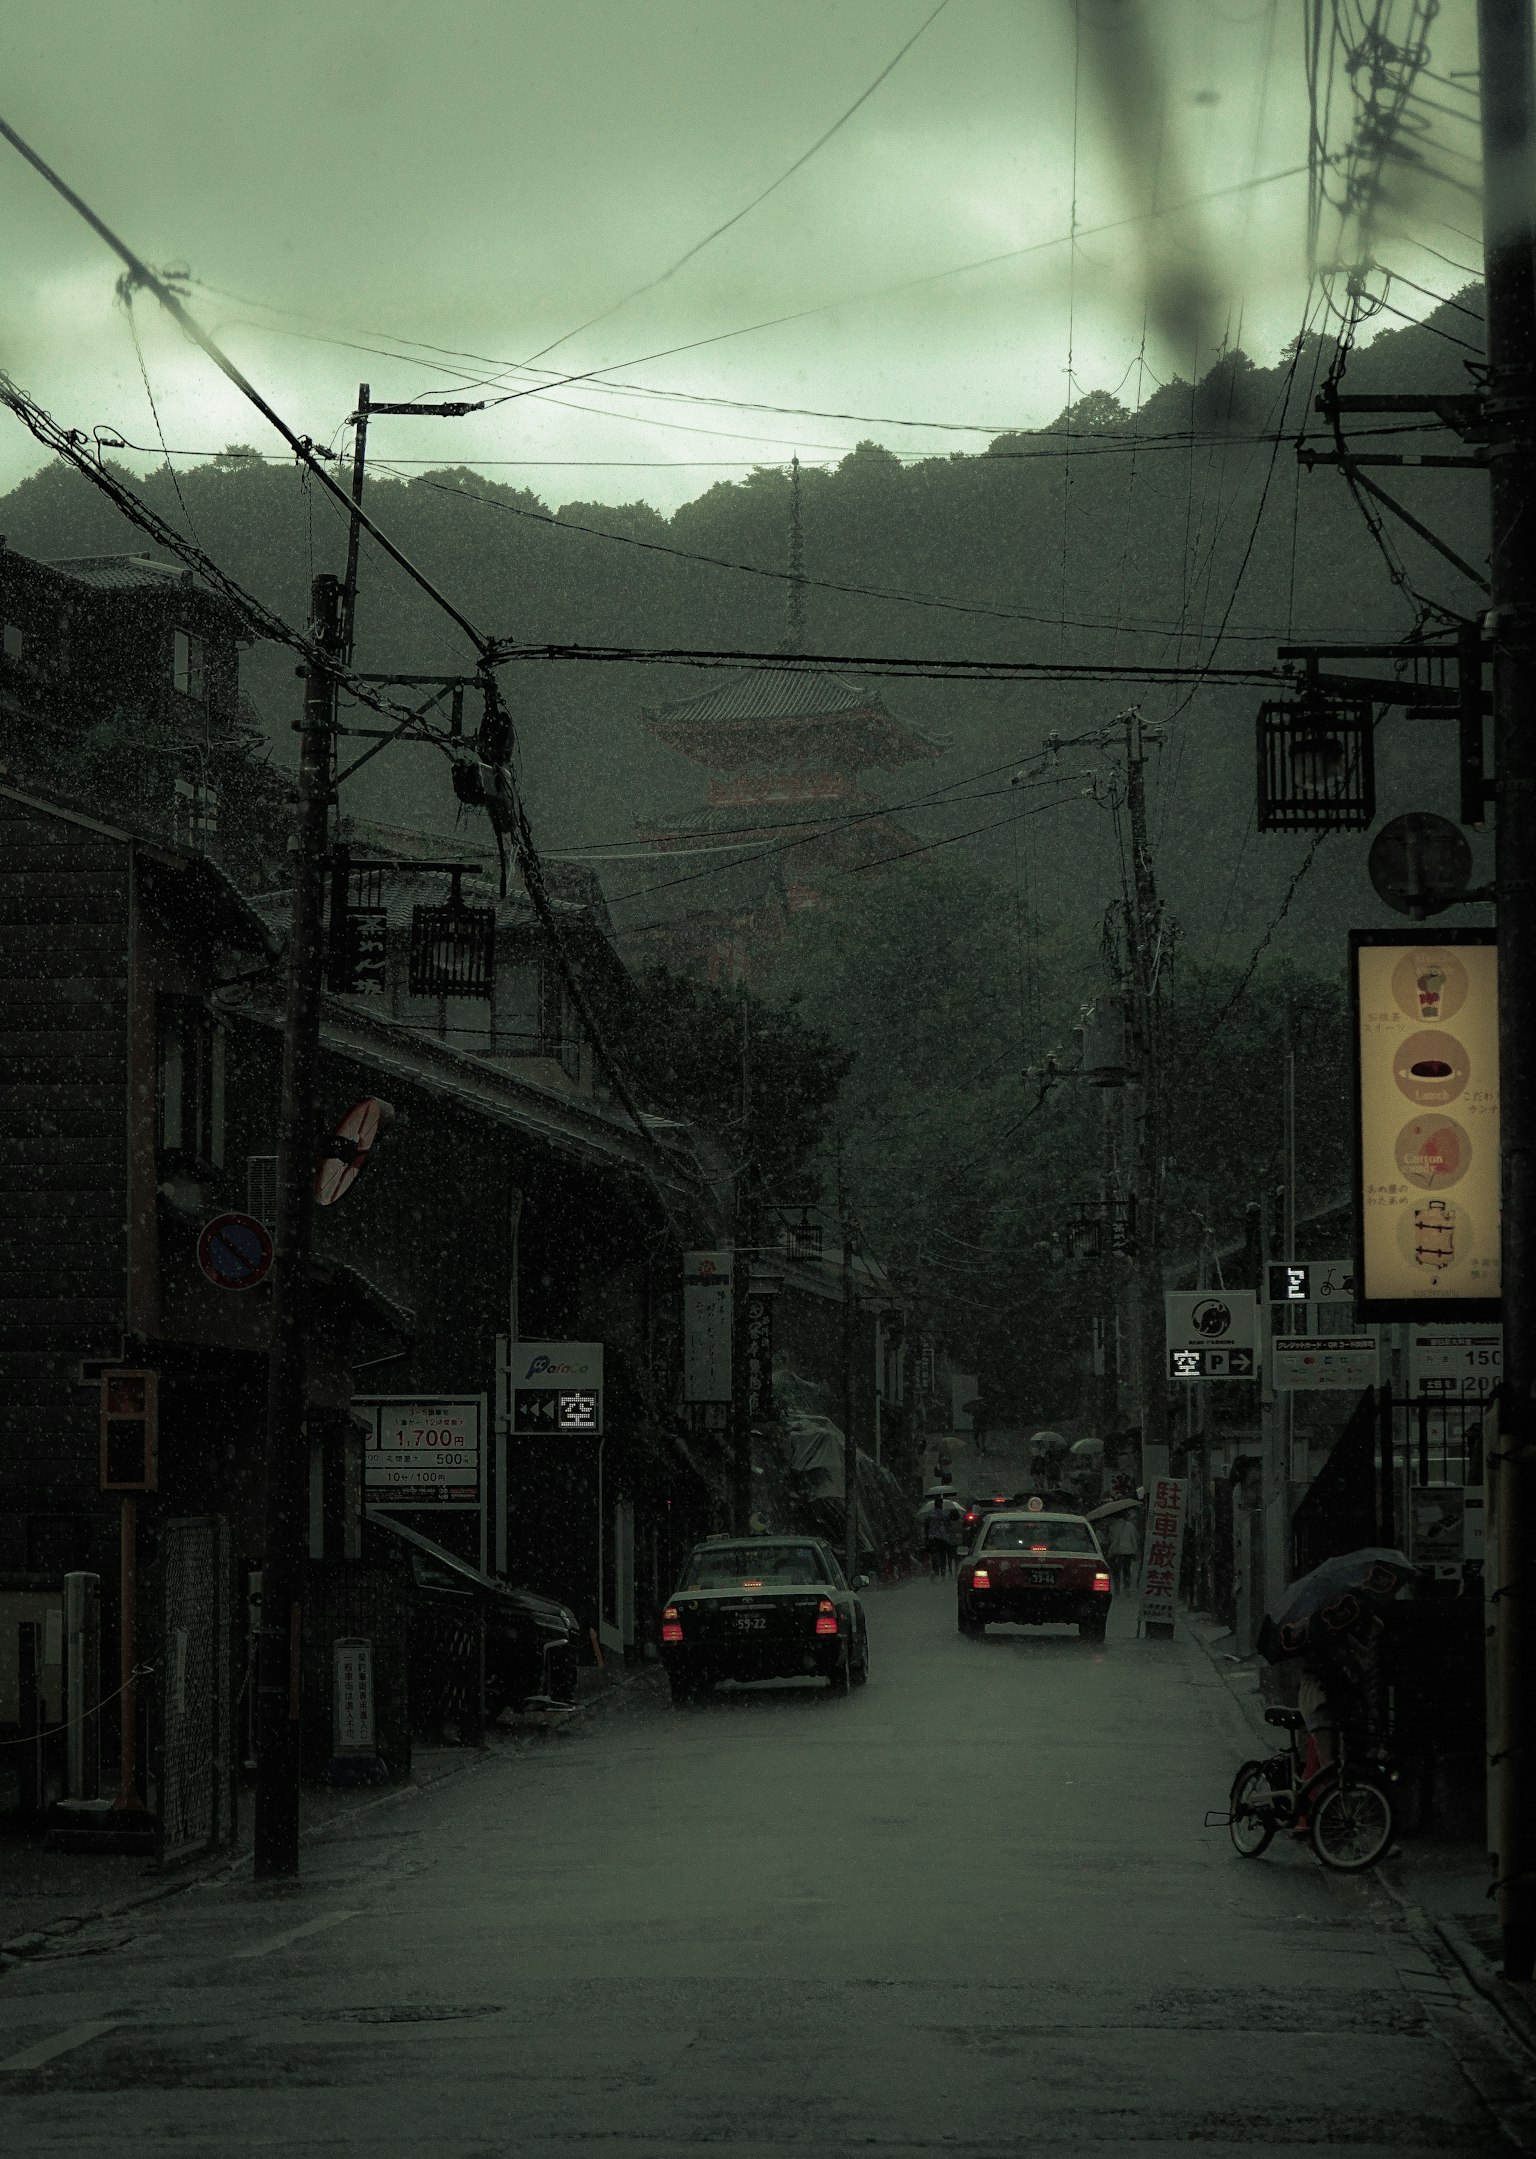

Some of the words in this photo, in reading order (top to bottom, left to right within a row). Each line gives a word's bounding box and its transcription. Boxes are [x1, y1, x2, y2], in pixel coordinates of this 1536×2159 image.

[1173, 1350, 1200, 1376] 空
[1210, 1355, 1224, 1370] P
[560, 1393, 595, 1427] 空
[396, 1429, 464, 1447] 1,700円
[1145, 1481, 1182, 1598] 駐車厳禁
